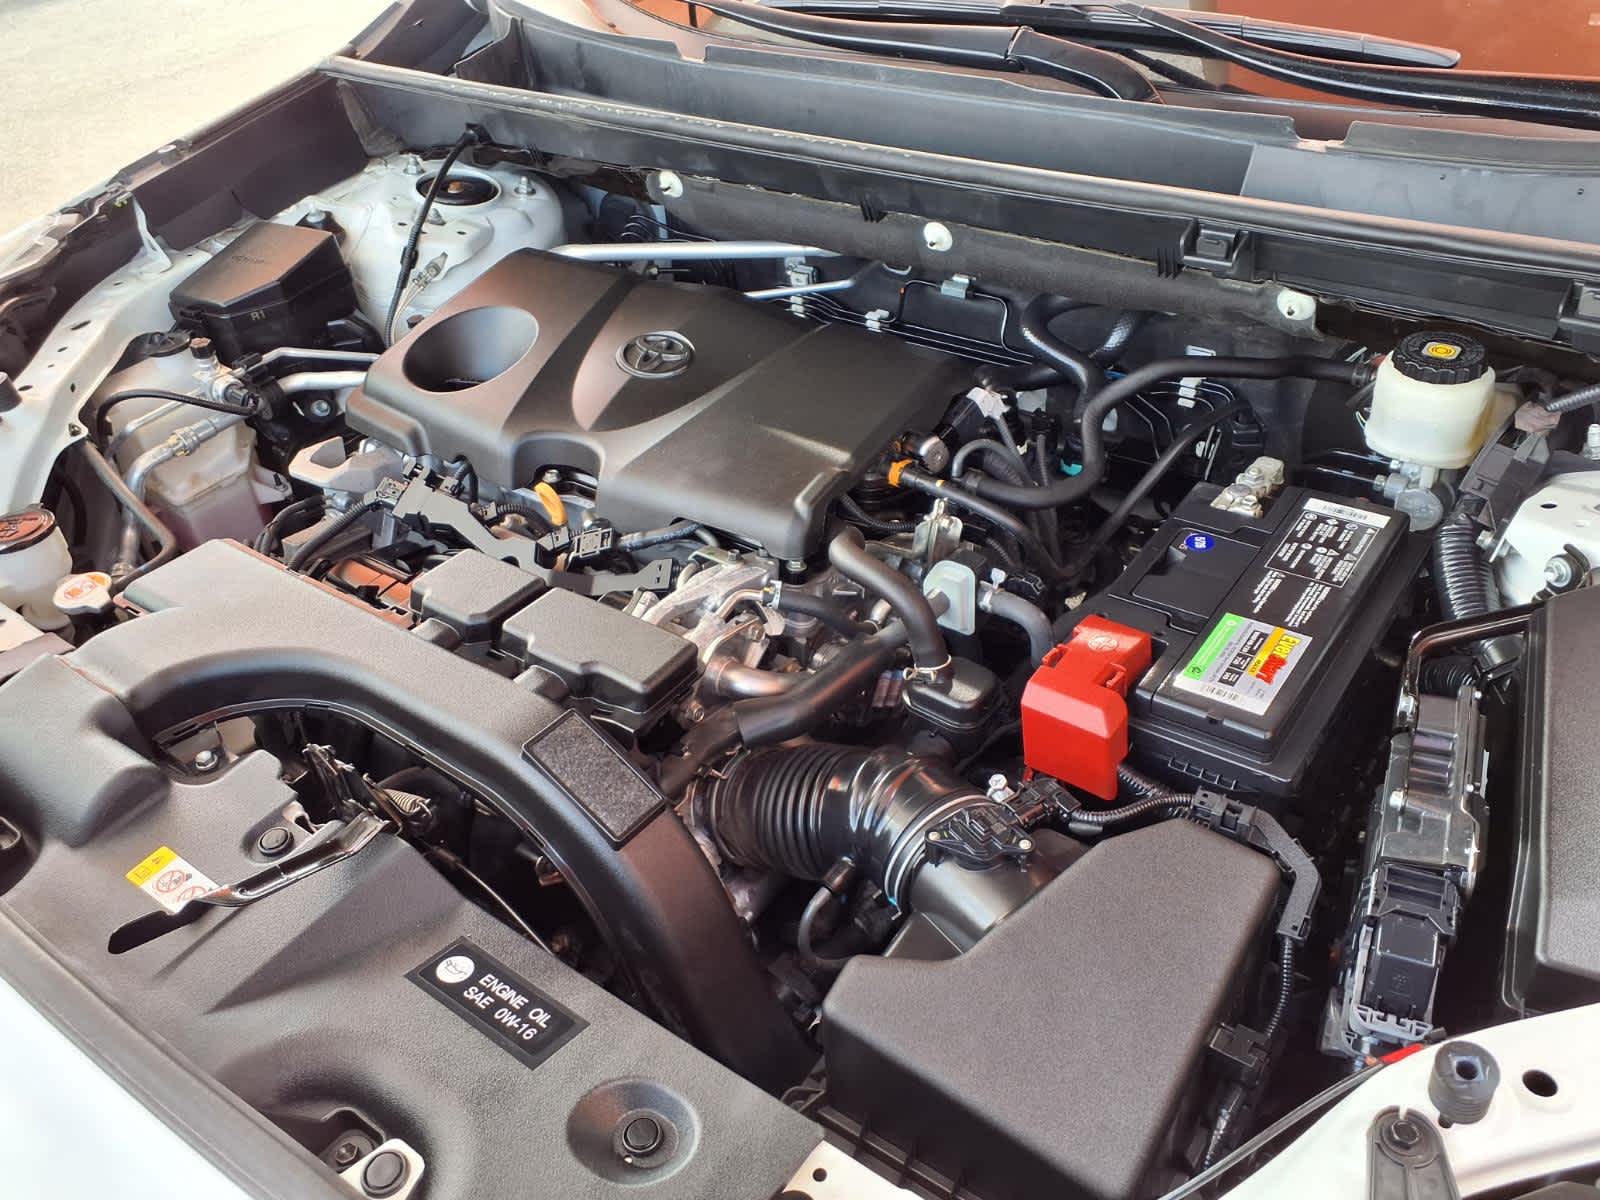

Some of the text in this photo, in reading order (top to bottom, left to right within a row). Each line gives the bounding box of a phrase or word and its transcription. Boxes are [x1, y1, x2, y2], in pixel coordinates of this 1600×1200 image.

[251, 311, 266, 321] R1
[463, 986, 538, 1041] SAE 0W-16
[478, 973, 553, 1029] ENGINE OIL
